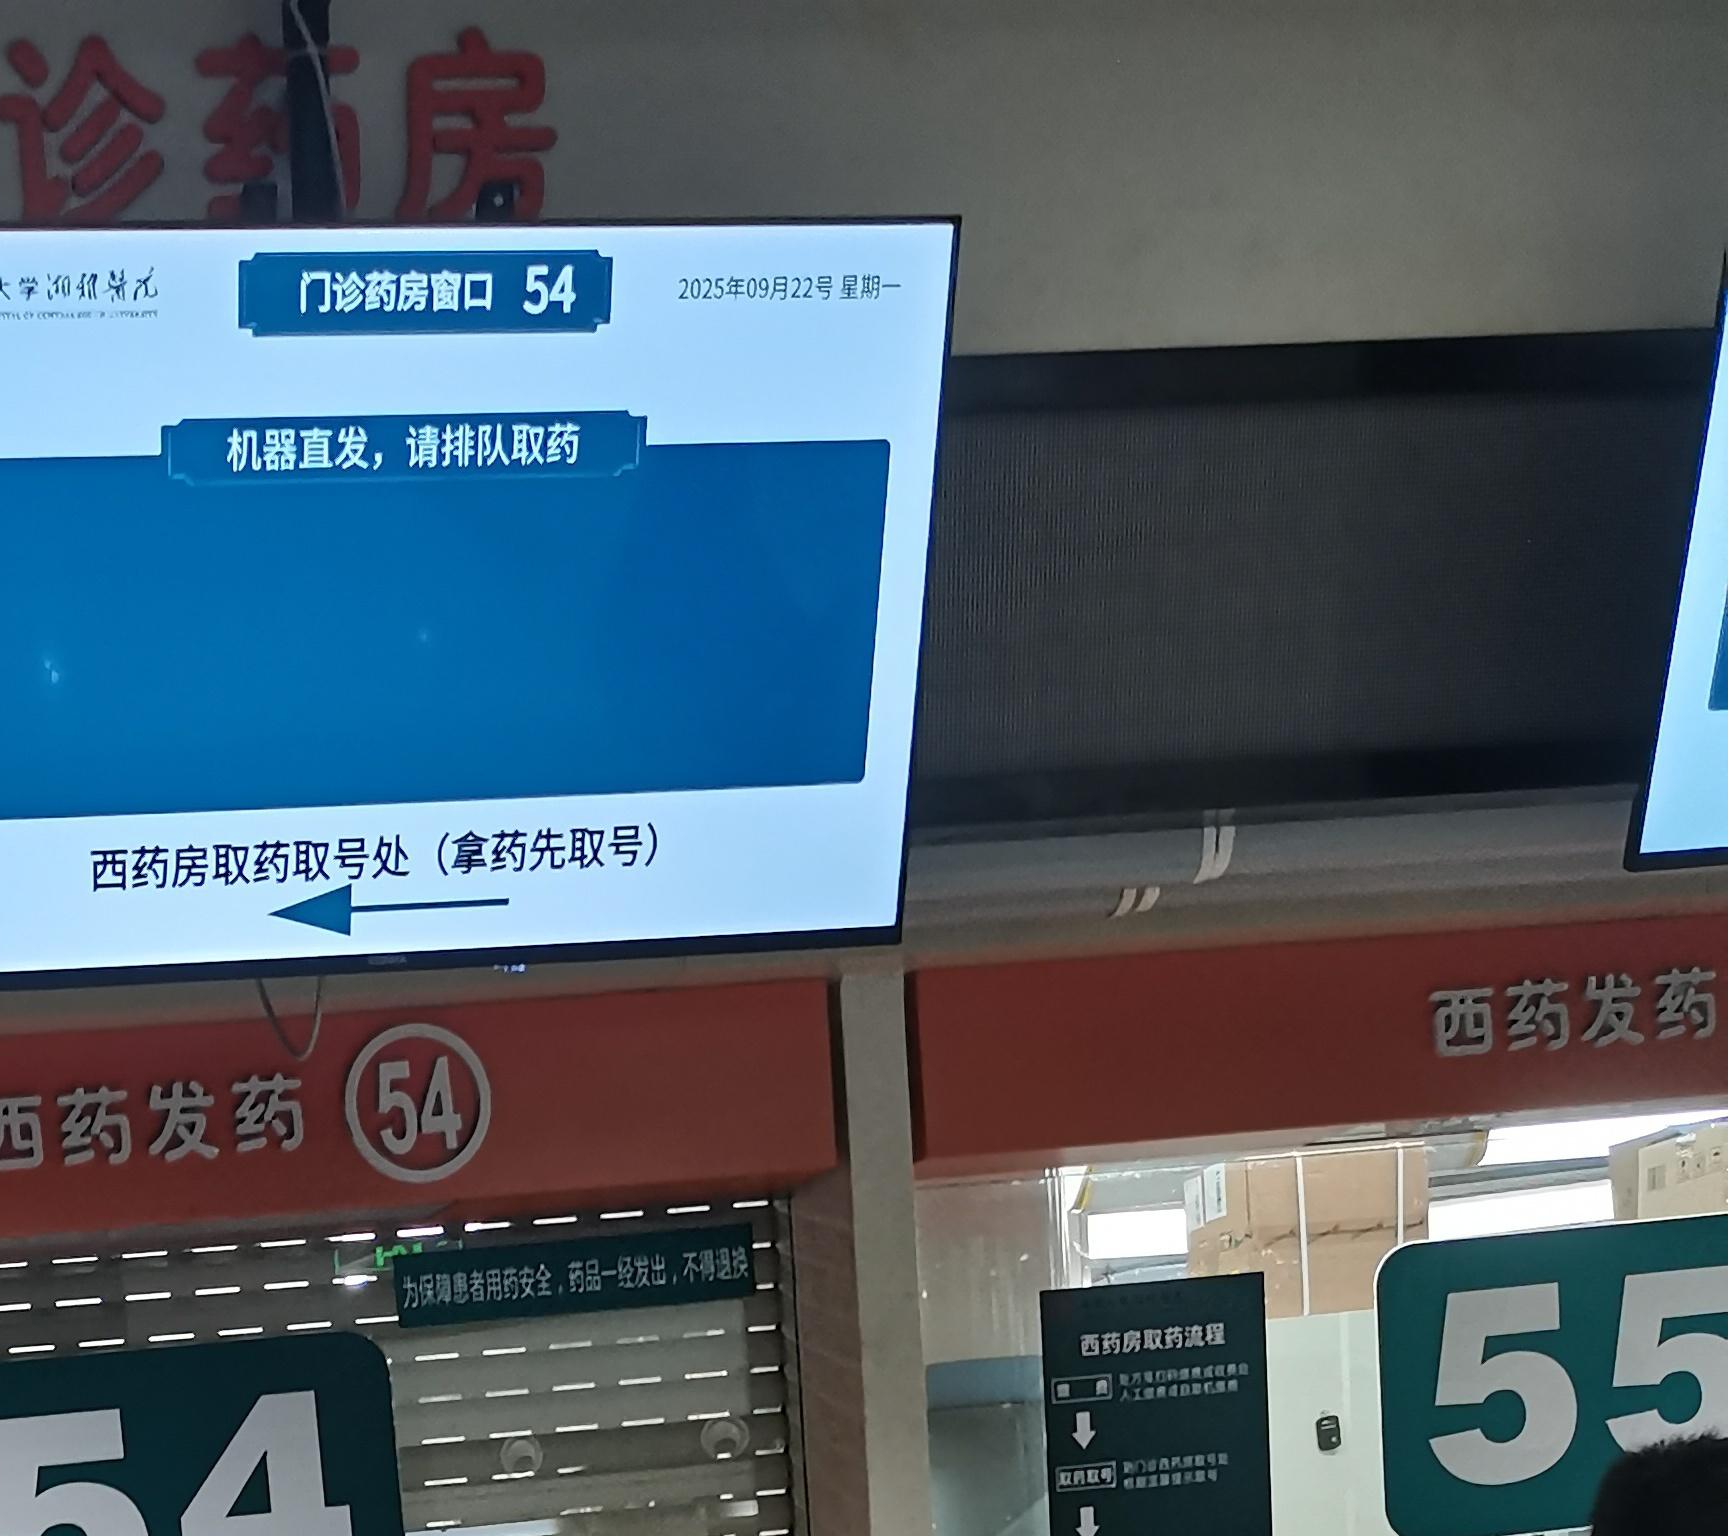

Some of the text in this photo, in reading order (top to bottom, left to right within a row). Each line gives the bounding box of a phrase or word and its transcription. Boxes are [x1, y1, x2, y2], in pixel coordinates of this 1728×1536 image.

[299, 265, 576, 316] 门诊药房窗口 54
[677, 275, 902, 301] 2025年09月22号 星期一
[227, 423, 581, 474] 机器直发，请排队取药
[91, 822, 661, 893] 西药房取药取号处（拿药先取号）
[1429, 967, 1717, 1058] 西药发药
[377, 1055, 462, 1155] 54
[1080, 1322, 1226, 1356] 西药房取药流程
[1429, 1266, 1728, 1486] 55
